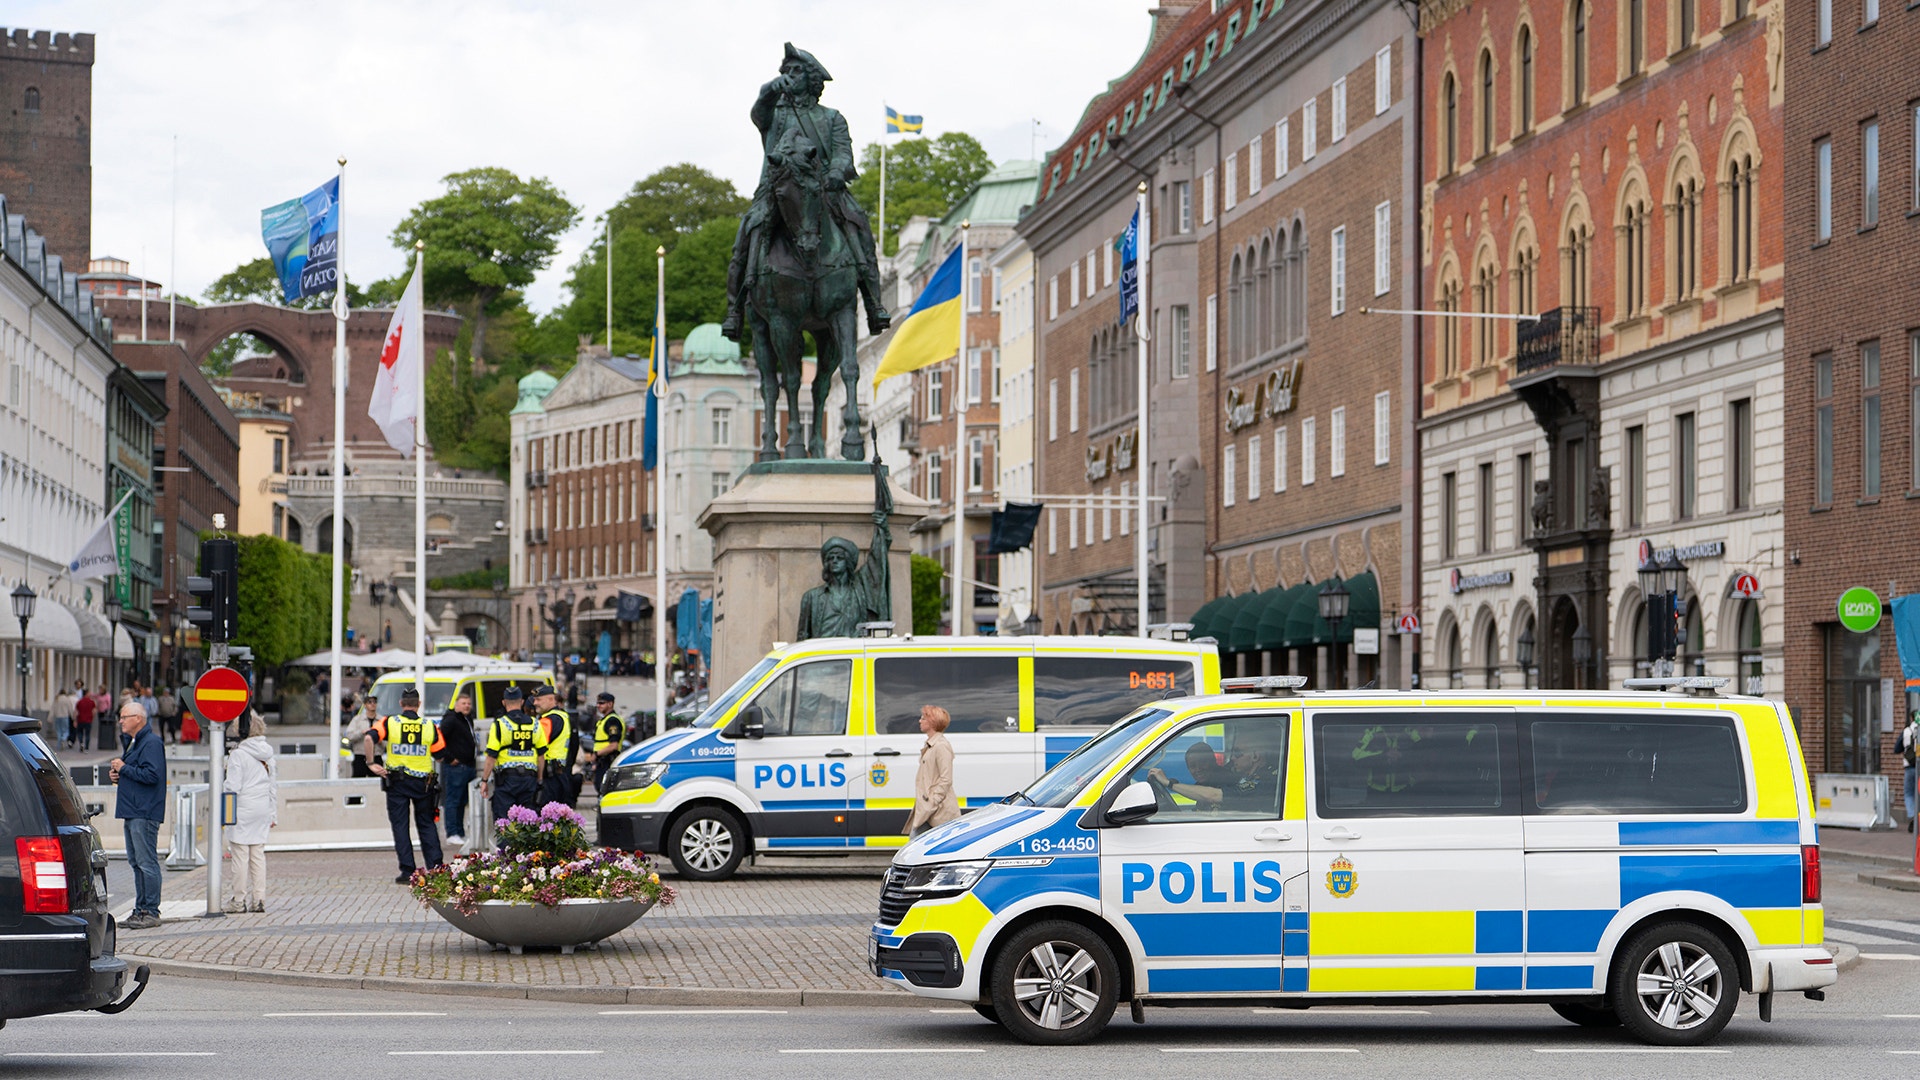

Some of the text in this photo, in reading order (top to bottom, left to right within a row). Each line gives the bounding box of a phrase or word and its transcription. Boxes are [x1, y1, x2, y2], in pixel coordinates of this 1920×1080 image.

[119, 507, 128, 595] CONDITORI
[1129, 671, 1175, 689] D-651
[402, 724, 421, 733] D65
[407, 733, 415, 744] 0
[513, 730, 531, 740] D65
[391, 744, 427, 756] POLIS
[519, 741, 525, 750] 1
[690, 746, 735, 756] 1 69-0220
[754, 762, 846, 789] POLIS
[1017, 836, 1095, 853] 1 63-4450
[1122, 860, 1283, 904] POLIS
